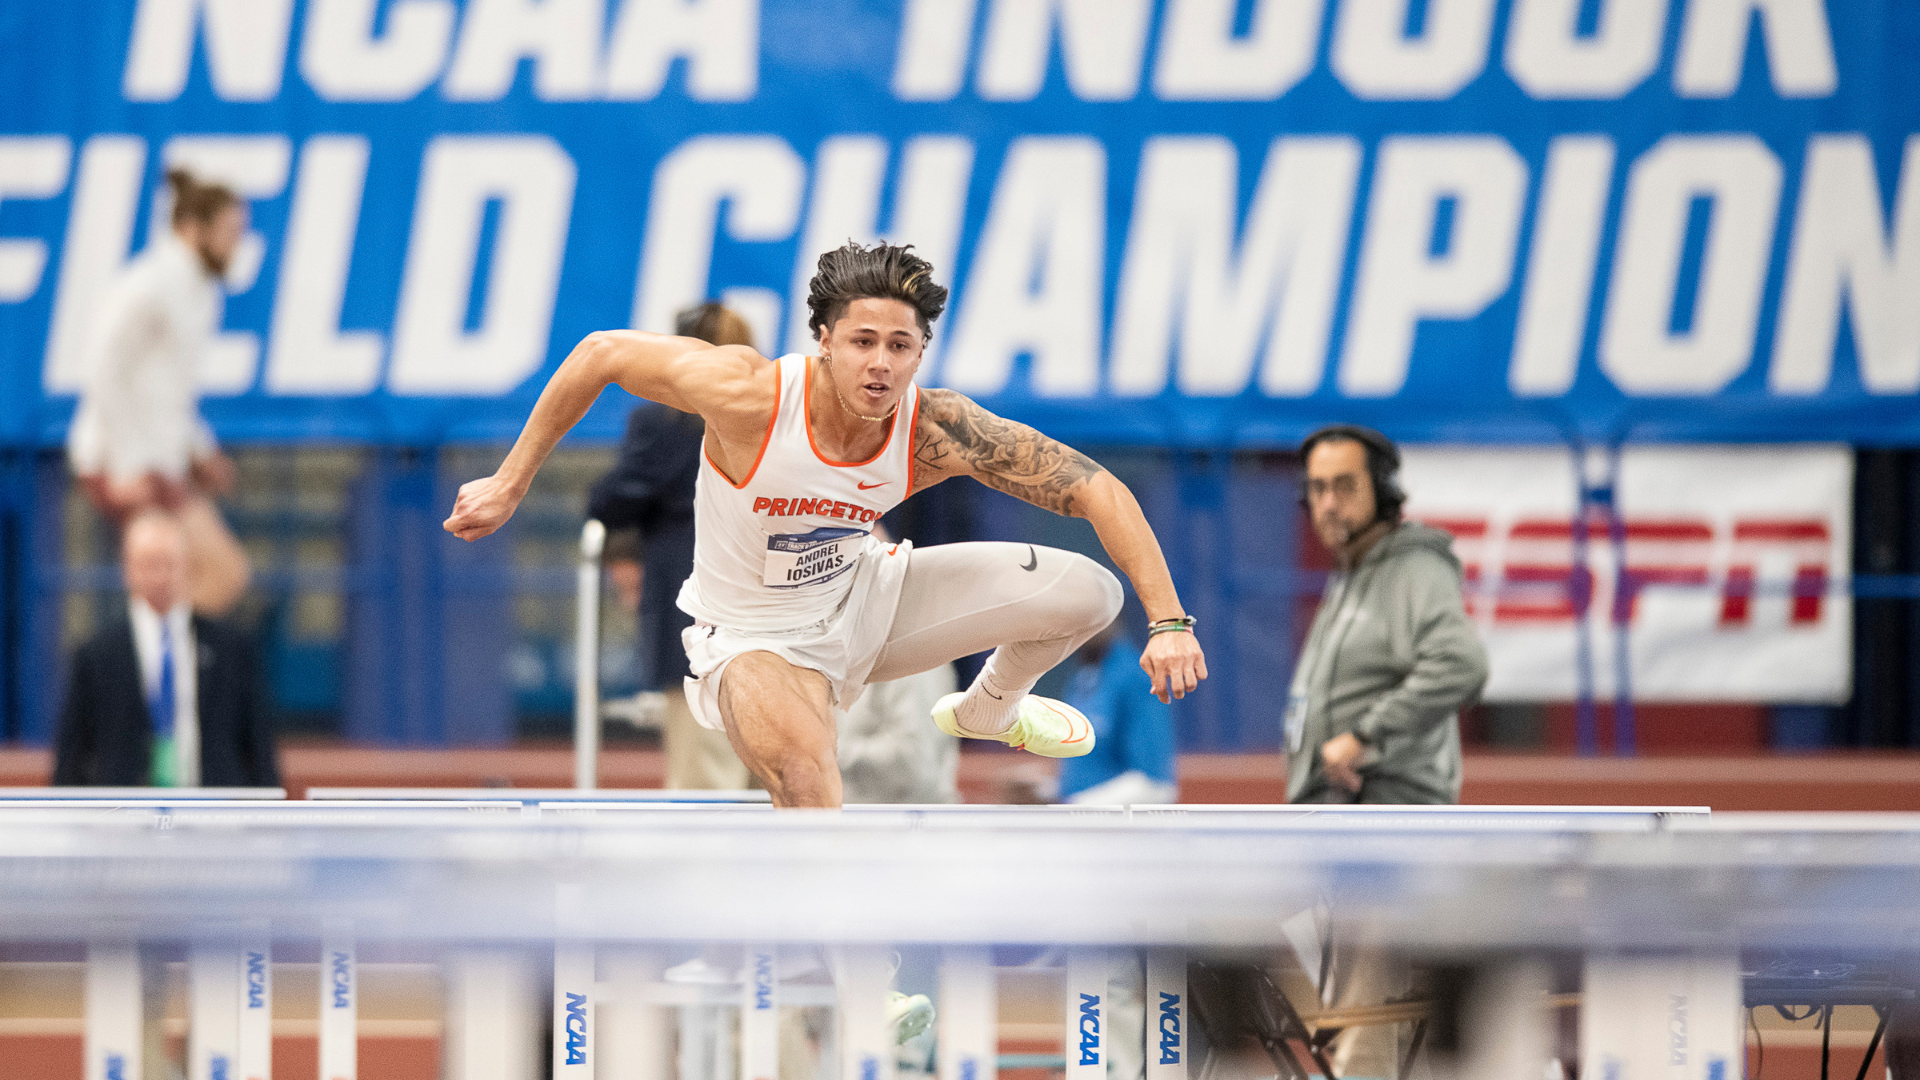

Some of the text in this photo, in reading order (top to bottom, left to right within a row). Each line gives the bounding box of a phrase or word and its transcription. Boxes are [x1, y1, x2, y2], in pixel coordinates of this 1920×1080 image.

[0, 135, 576, 397] IELD
[787, 554, 844, 581] IOSIVAS
[795, 543, 839, 567] ANDREI
[566, 991, 587, 1065] NCAA
[1079, 992, 1100, 1066] NCAA
[1159, 991, 1181, 1065] NCAA
